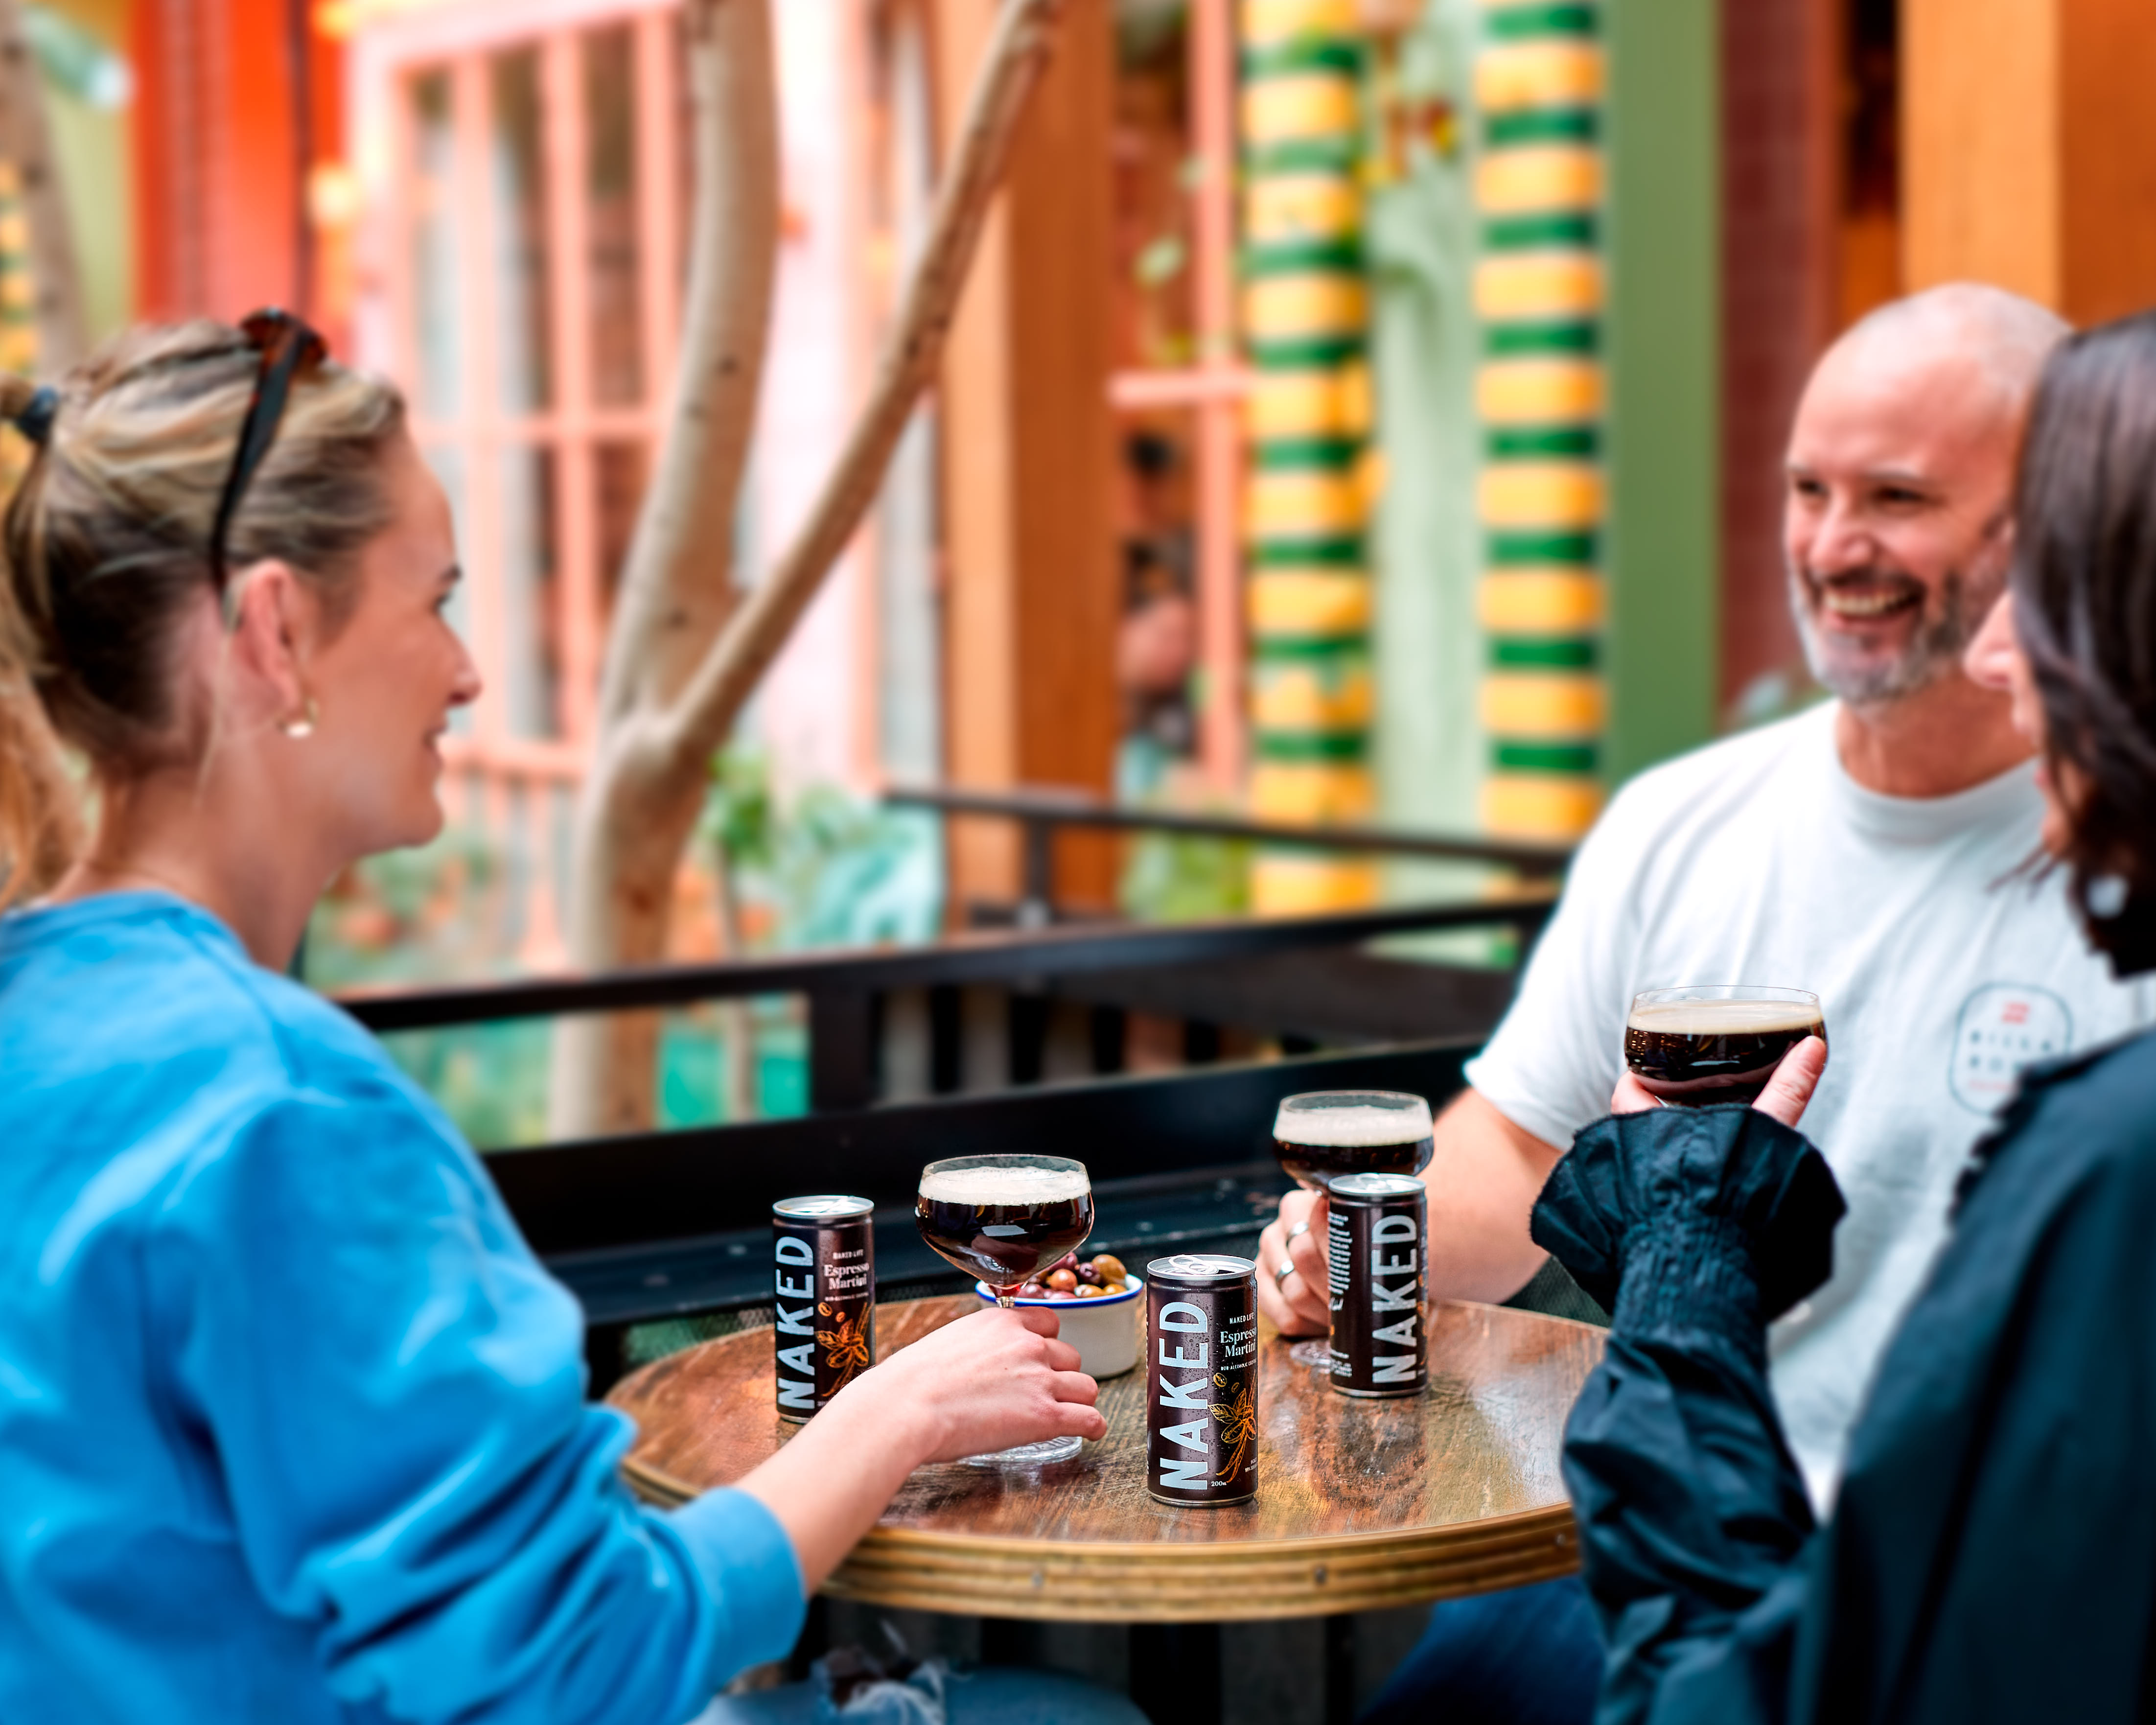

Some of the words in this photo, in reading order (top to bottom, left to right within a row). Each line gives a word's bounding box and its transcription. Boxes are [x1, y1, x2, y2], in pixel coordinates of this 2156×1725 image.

[824, 1263, 869, 1279] Espresso
[829, 1273, 867, 1290] Martini
[1371, 1214, 1417, 1383] NAKED
[776, 1236, 815, 1409] NAKED
[1229, 1315, 1246, 1324] NAKED
[1225, 1339, 1255, 1357] Martini
[1159, 1301, 1208, 1490] NAKED
